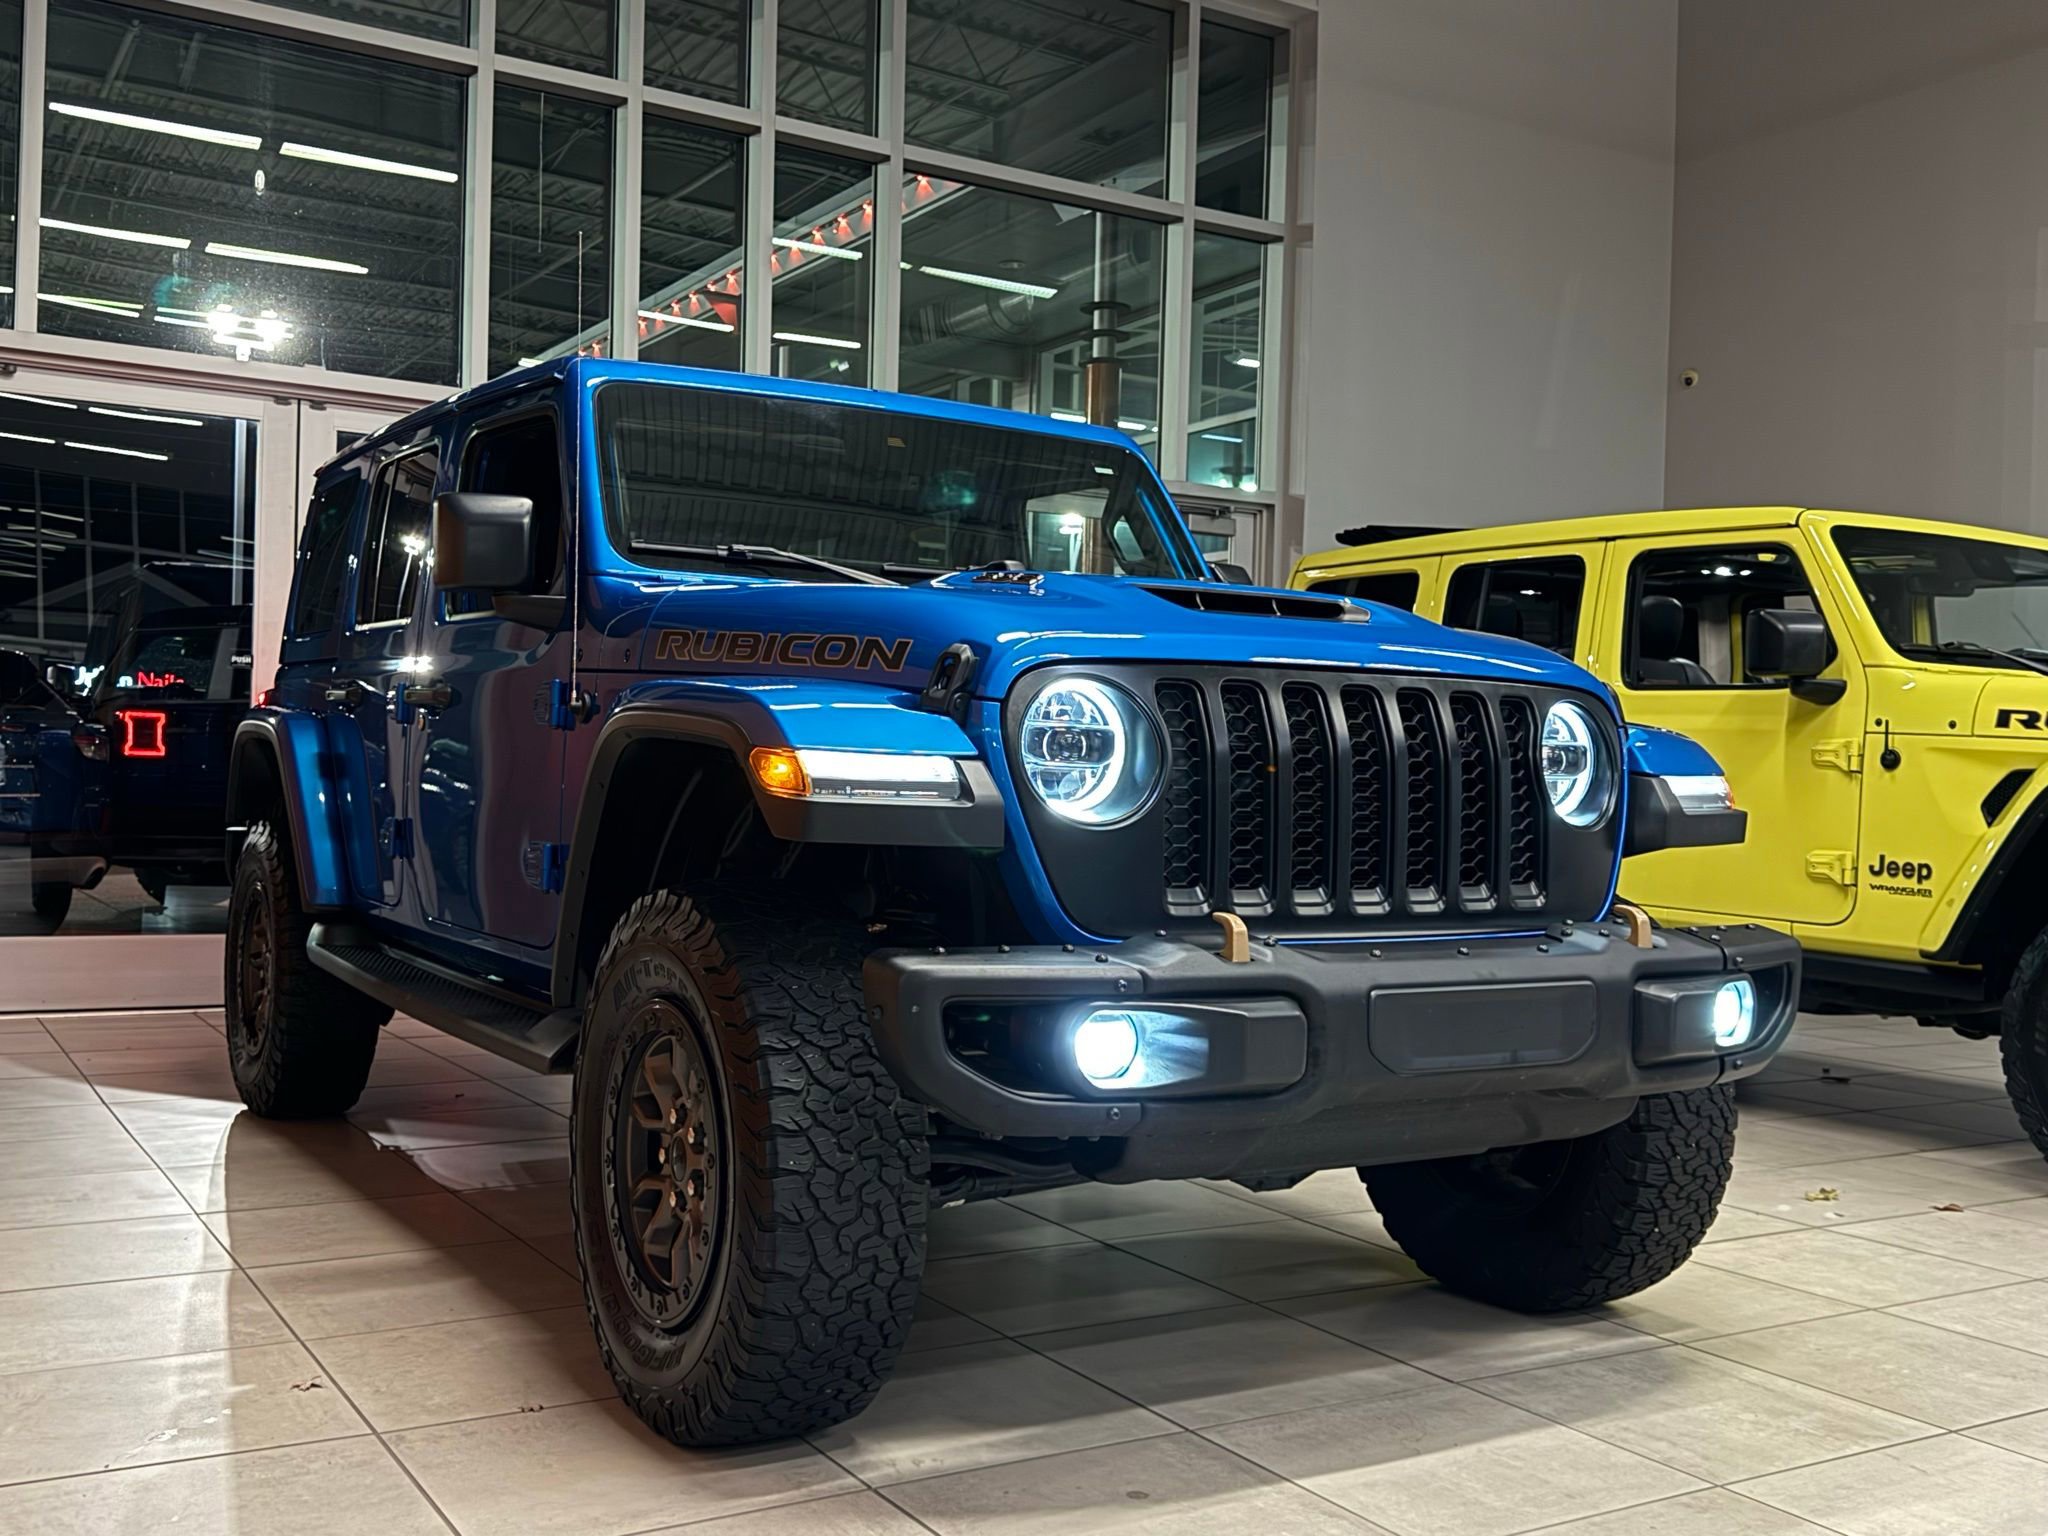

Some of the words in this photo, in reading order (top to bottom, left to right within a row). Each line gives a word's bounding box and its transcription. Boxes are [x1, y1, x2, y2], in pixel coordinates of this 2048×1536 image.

[231, 655, 252, 664] PUSH
[655, 629, 914, 672] RUBICON
[1994, 709, 2048, 731] R
[1868, 854, 1932, 885] Jeep
[1869, 883, 1932, 896] WRANGLER
